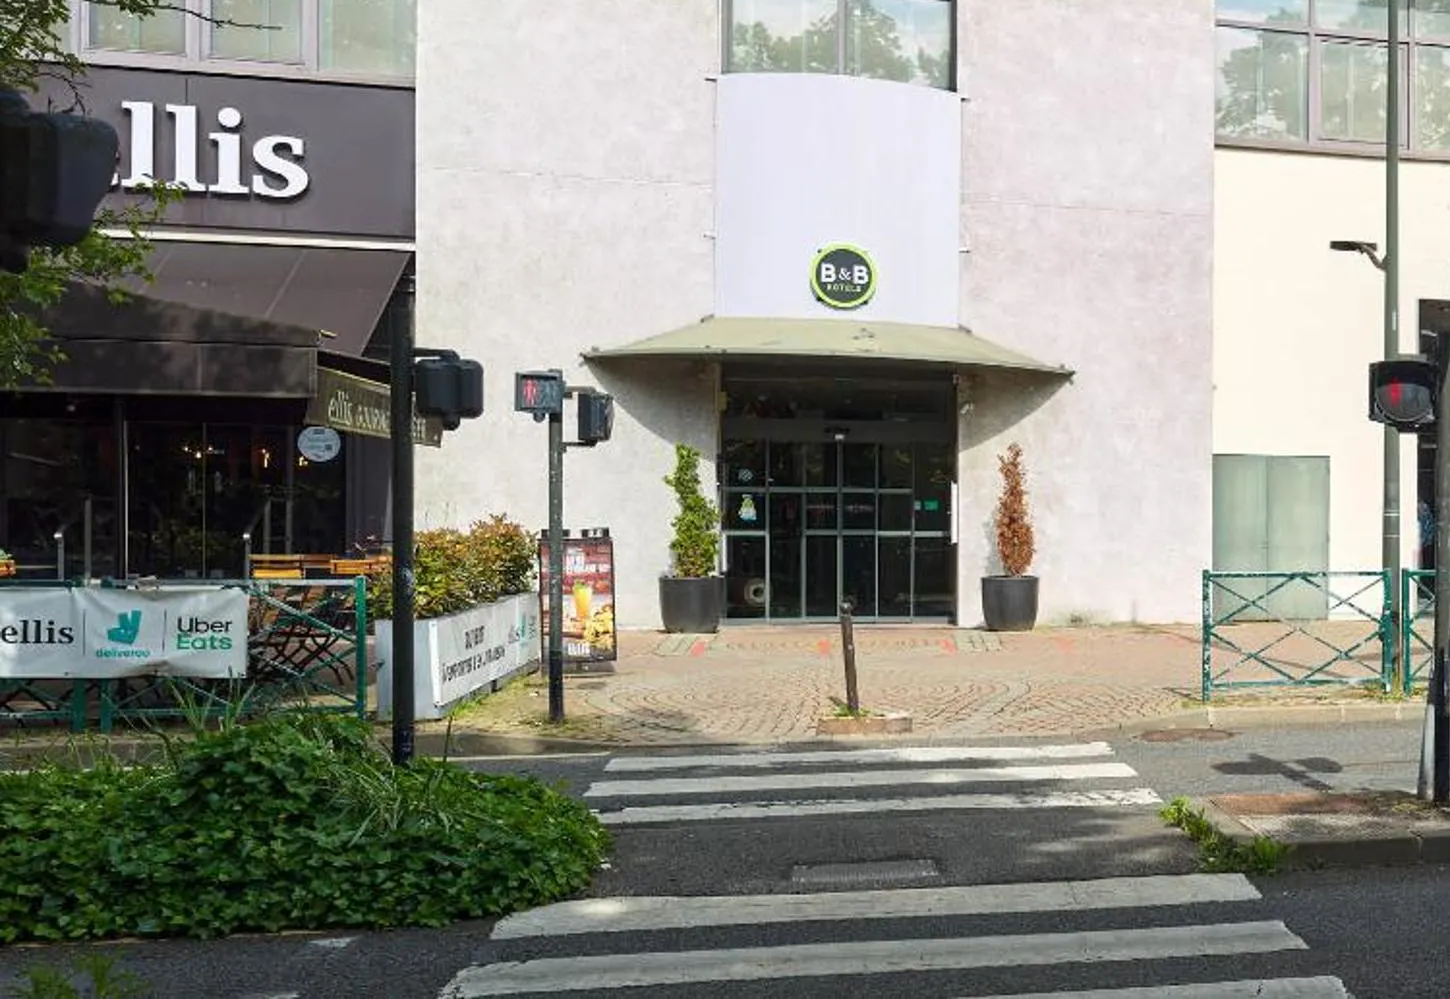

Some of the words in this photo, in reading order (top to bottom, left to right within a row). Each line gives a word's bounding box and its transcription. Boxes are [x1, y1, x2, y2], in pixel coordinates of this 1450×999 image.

[111, 100, 310, 198] llis
[1, 619, 75, 645] ellis
[176, 616, 233, 633] Uber
[176, 634, 233, 650] Eats
